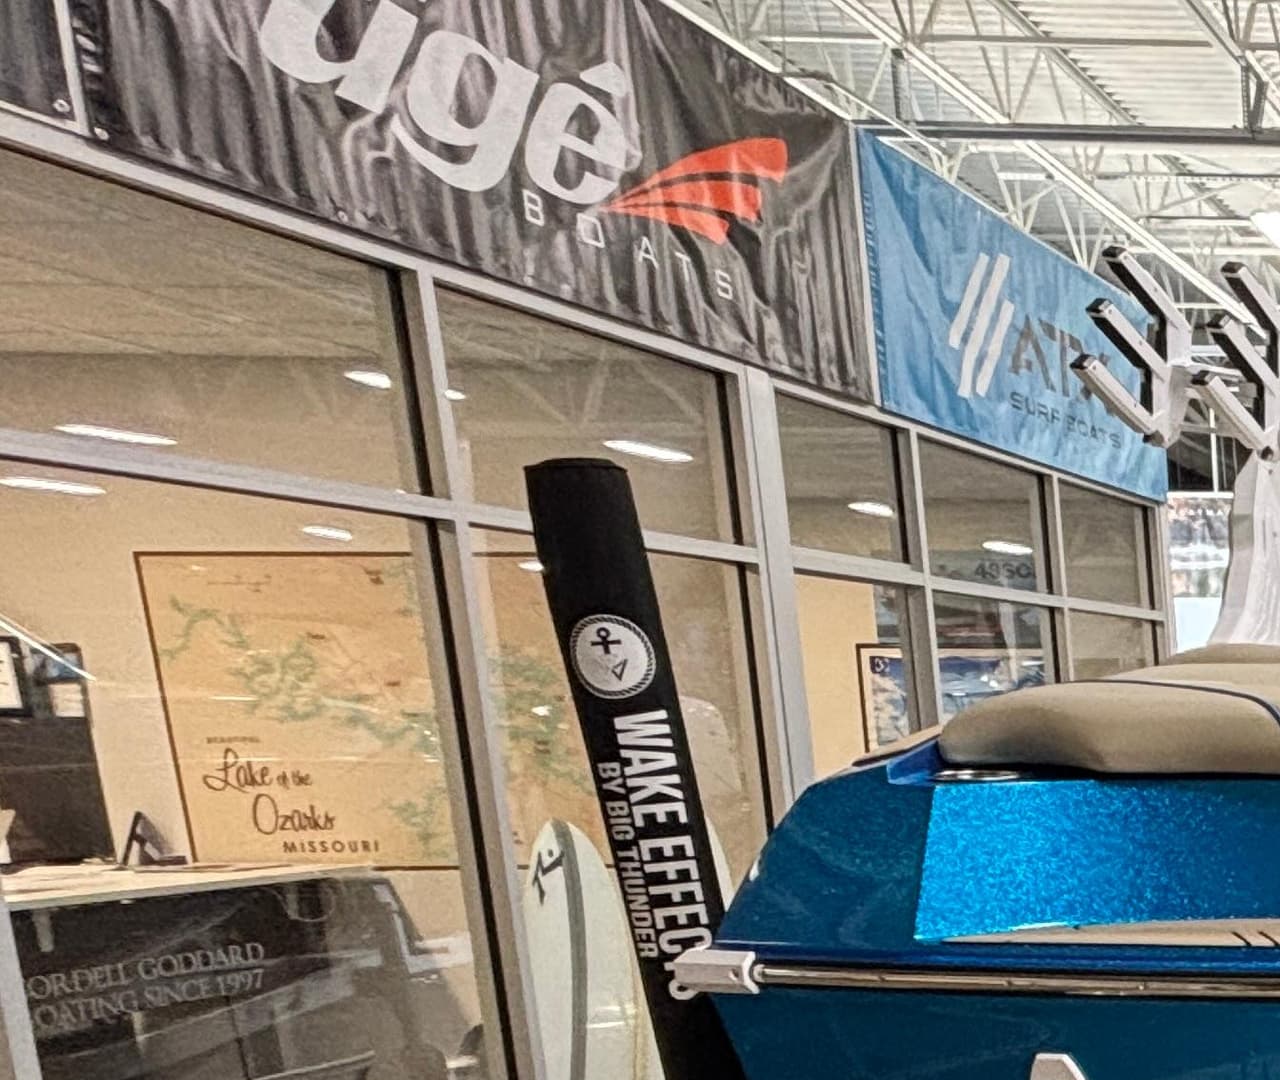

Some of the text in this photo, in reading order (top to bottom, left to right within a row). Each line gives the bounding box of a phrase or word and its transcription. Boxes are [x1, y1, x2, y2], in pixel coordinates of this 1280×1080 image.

[523, 190, 733, 300] BOATS
[1010, 391, 1122, 449] SURF BOATS
[203, 748, 273, 793] Lake
[613, 709, 688, 827] WAKE
[252, 794, 335, 835] Ozarks
[597, 762, 659, 958] BY BIG THUNDER
[26, 943, 265, 1000] ORDELL GODDARD
[33, 968, 264, 1030] OATING SINCE 1997
